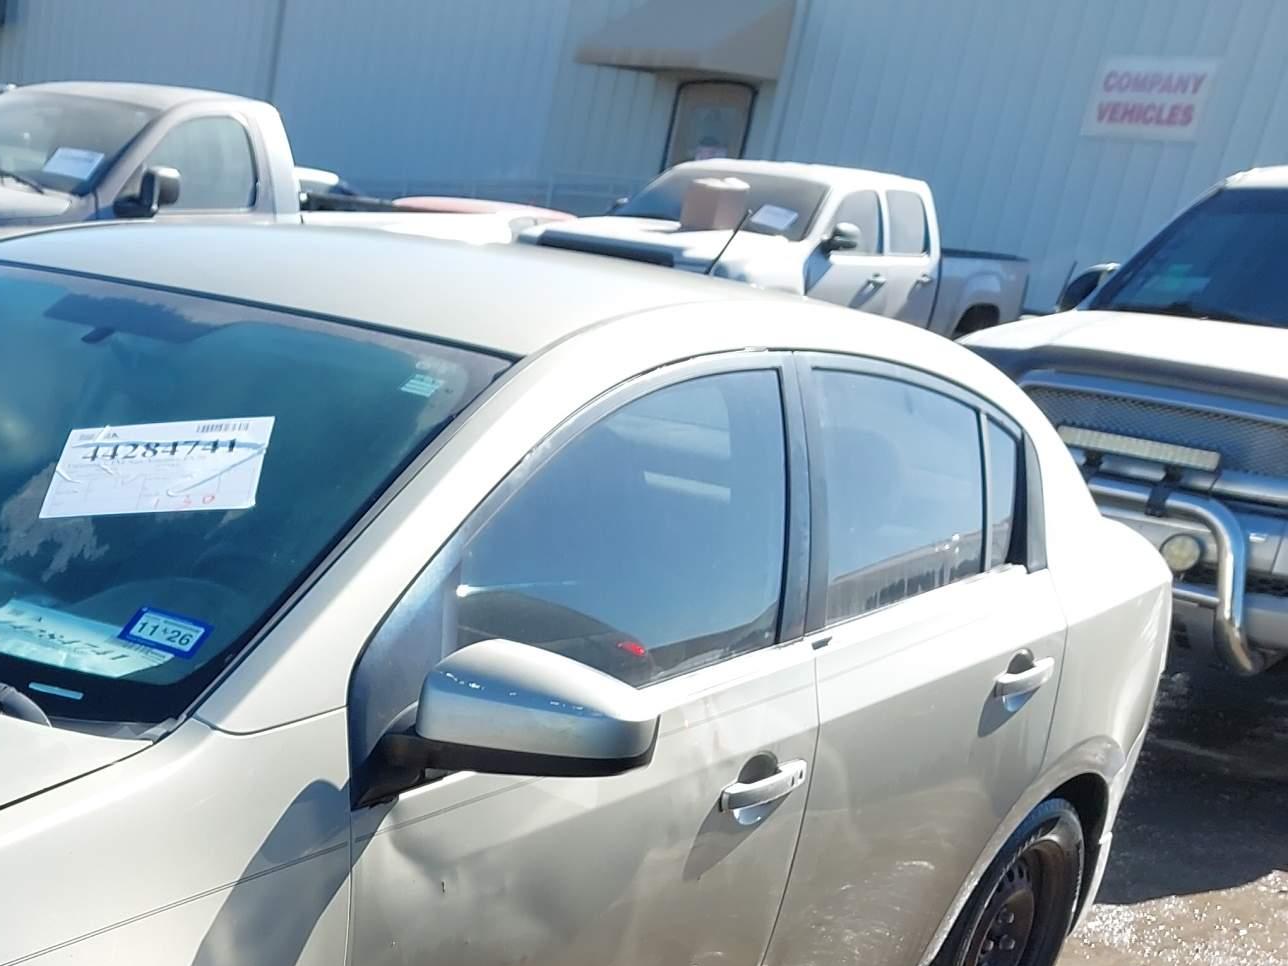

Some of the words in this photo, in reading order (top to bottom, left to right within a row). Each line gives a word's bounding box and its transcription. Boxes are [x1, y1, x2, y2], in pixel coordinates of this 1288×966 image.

[1103, 70, 1208, 94] COMPANY
[1096, 101, 1194, 126] VEHICLES
[82, 438, 237, 462] 44284741
[137, 621, 160, 636] 11
[166, 630, 194, 647] 26
